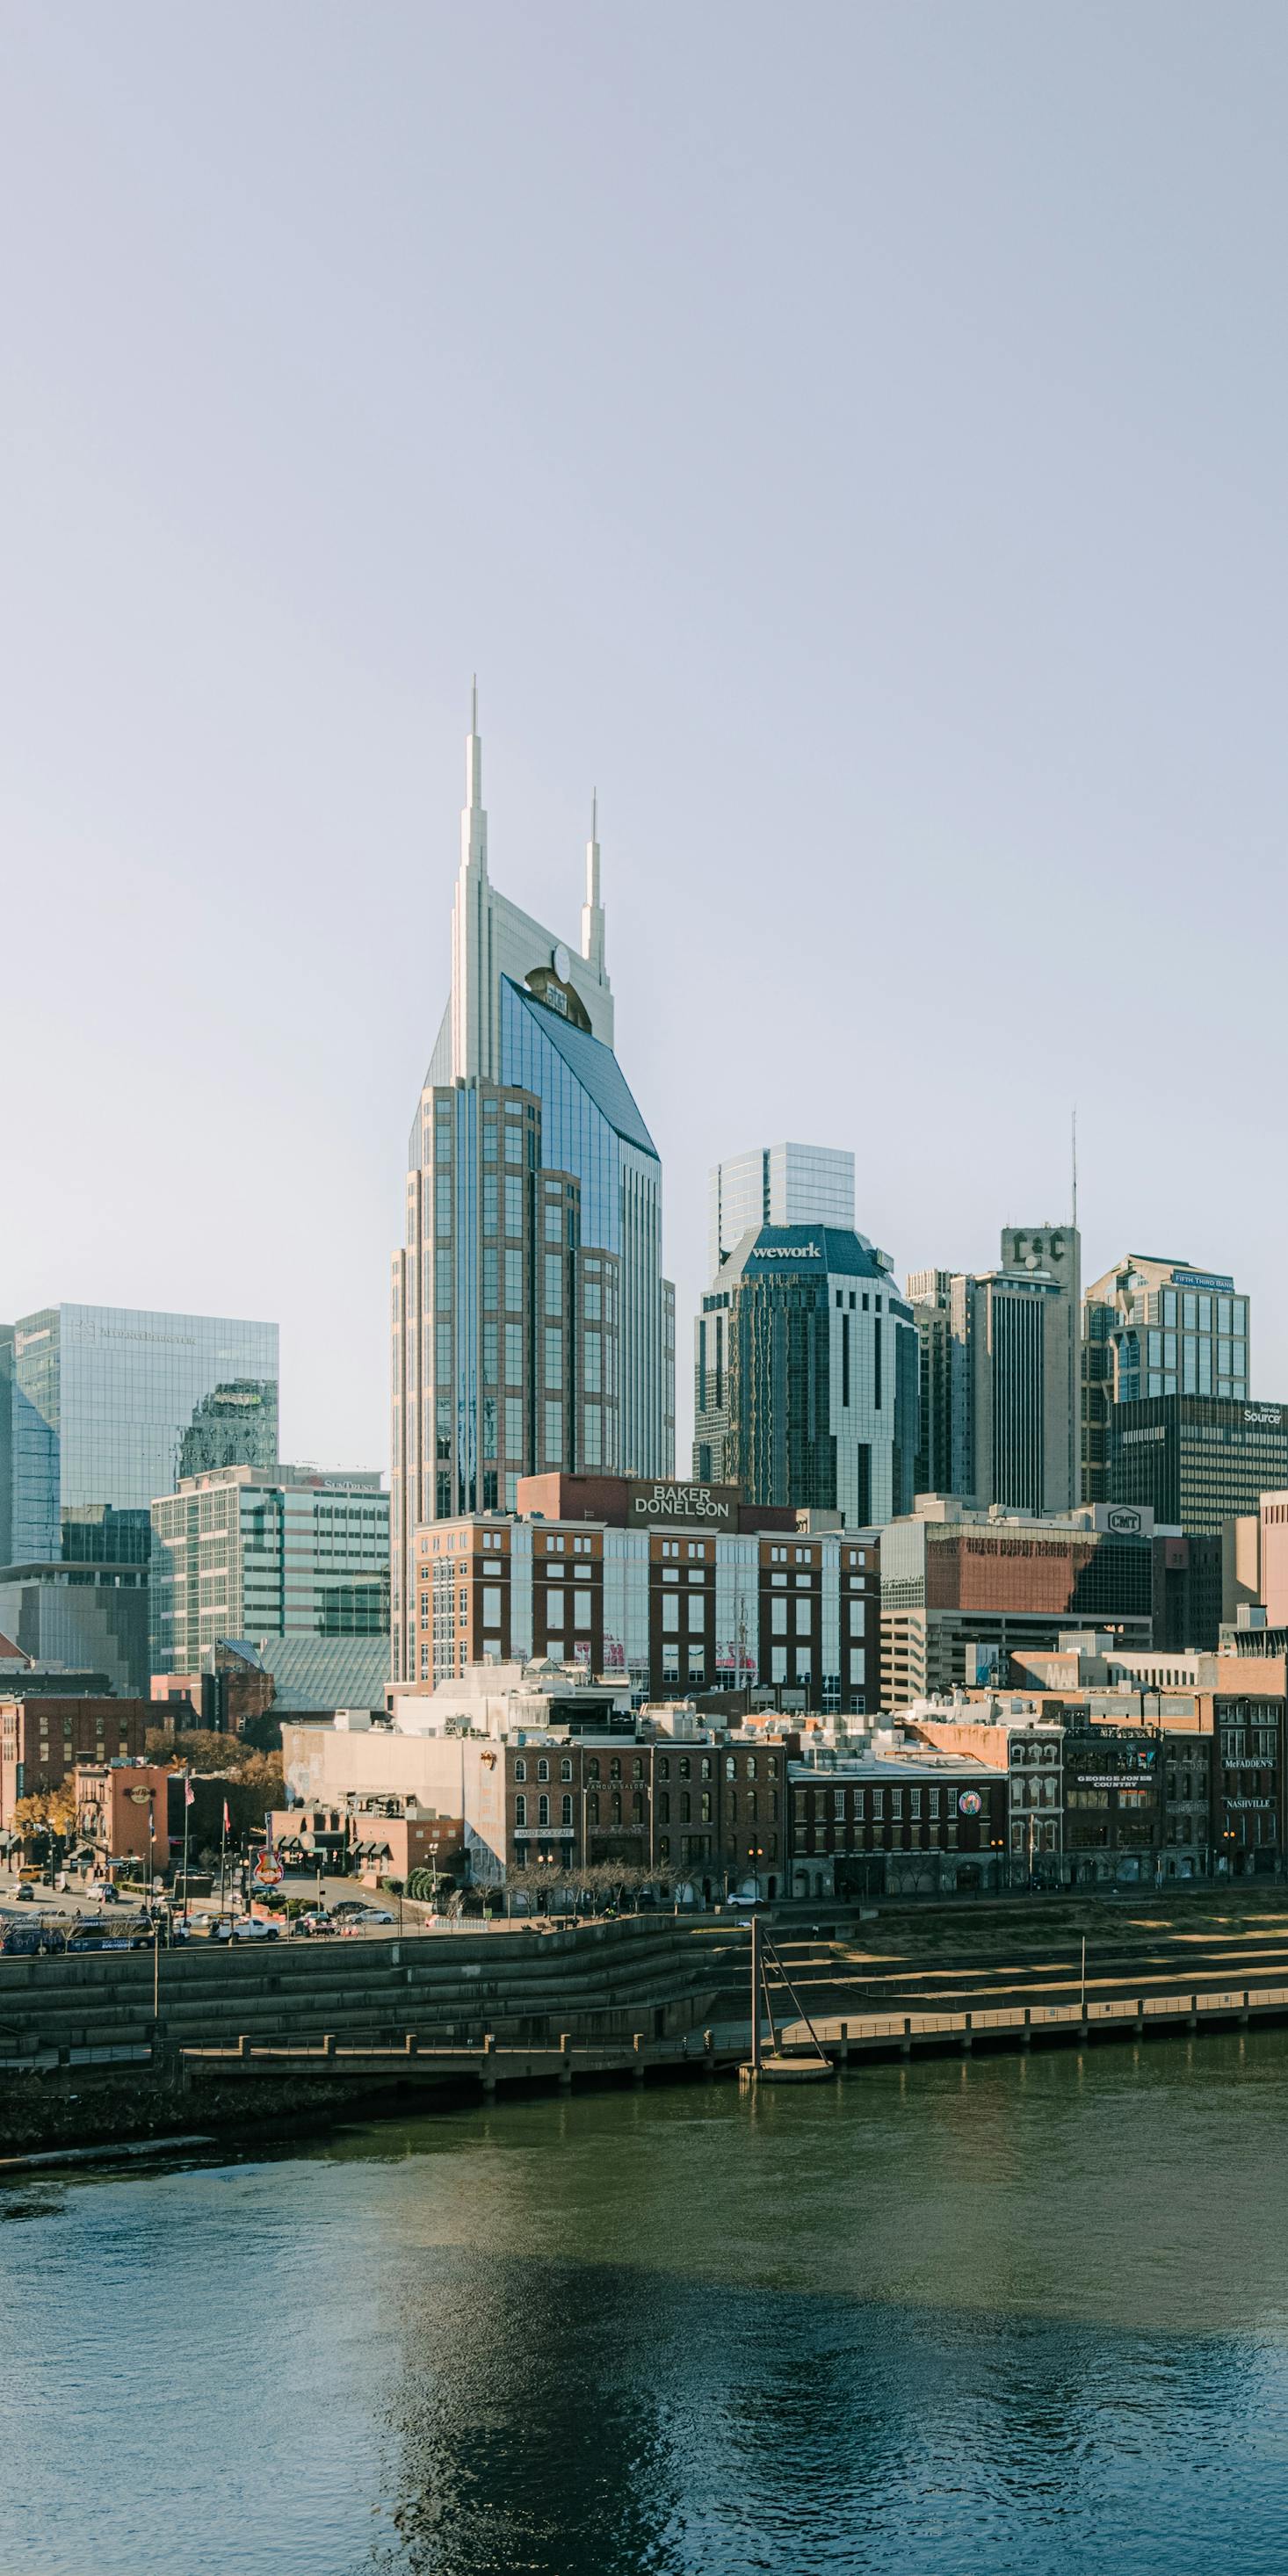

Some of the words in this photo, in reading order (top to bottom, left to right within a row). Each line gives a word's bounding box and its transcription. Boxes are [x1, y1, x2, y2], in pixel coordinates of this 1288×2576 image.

[753, 1241, 821, 1258] wework
[1244, 1409, 1280, 1424] Source
[1260, 1406, 1280, 1415] Service
[654, 1485, 711, 1503] BAKER
[635, 1498, 729, 1517] DONELSON
[1111, 1515, 1138, 1529] CMT
[1226, 1760, 1274, 1769] McFADDEN'S
[1226, 1799, 1271, 1808] NASHVILLE
